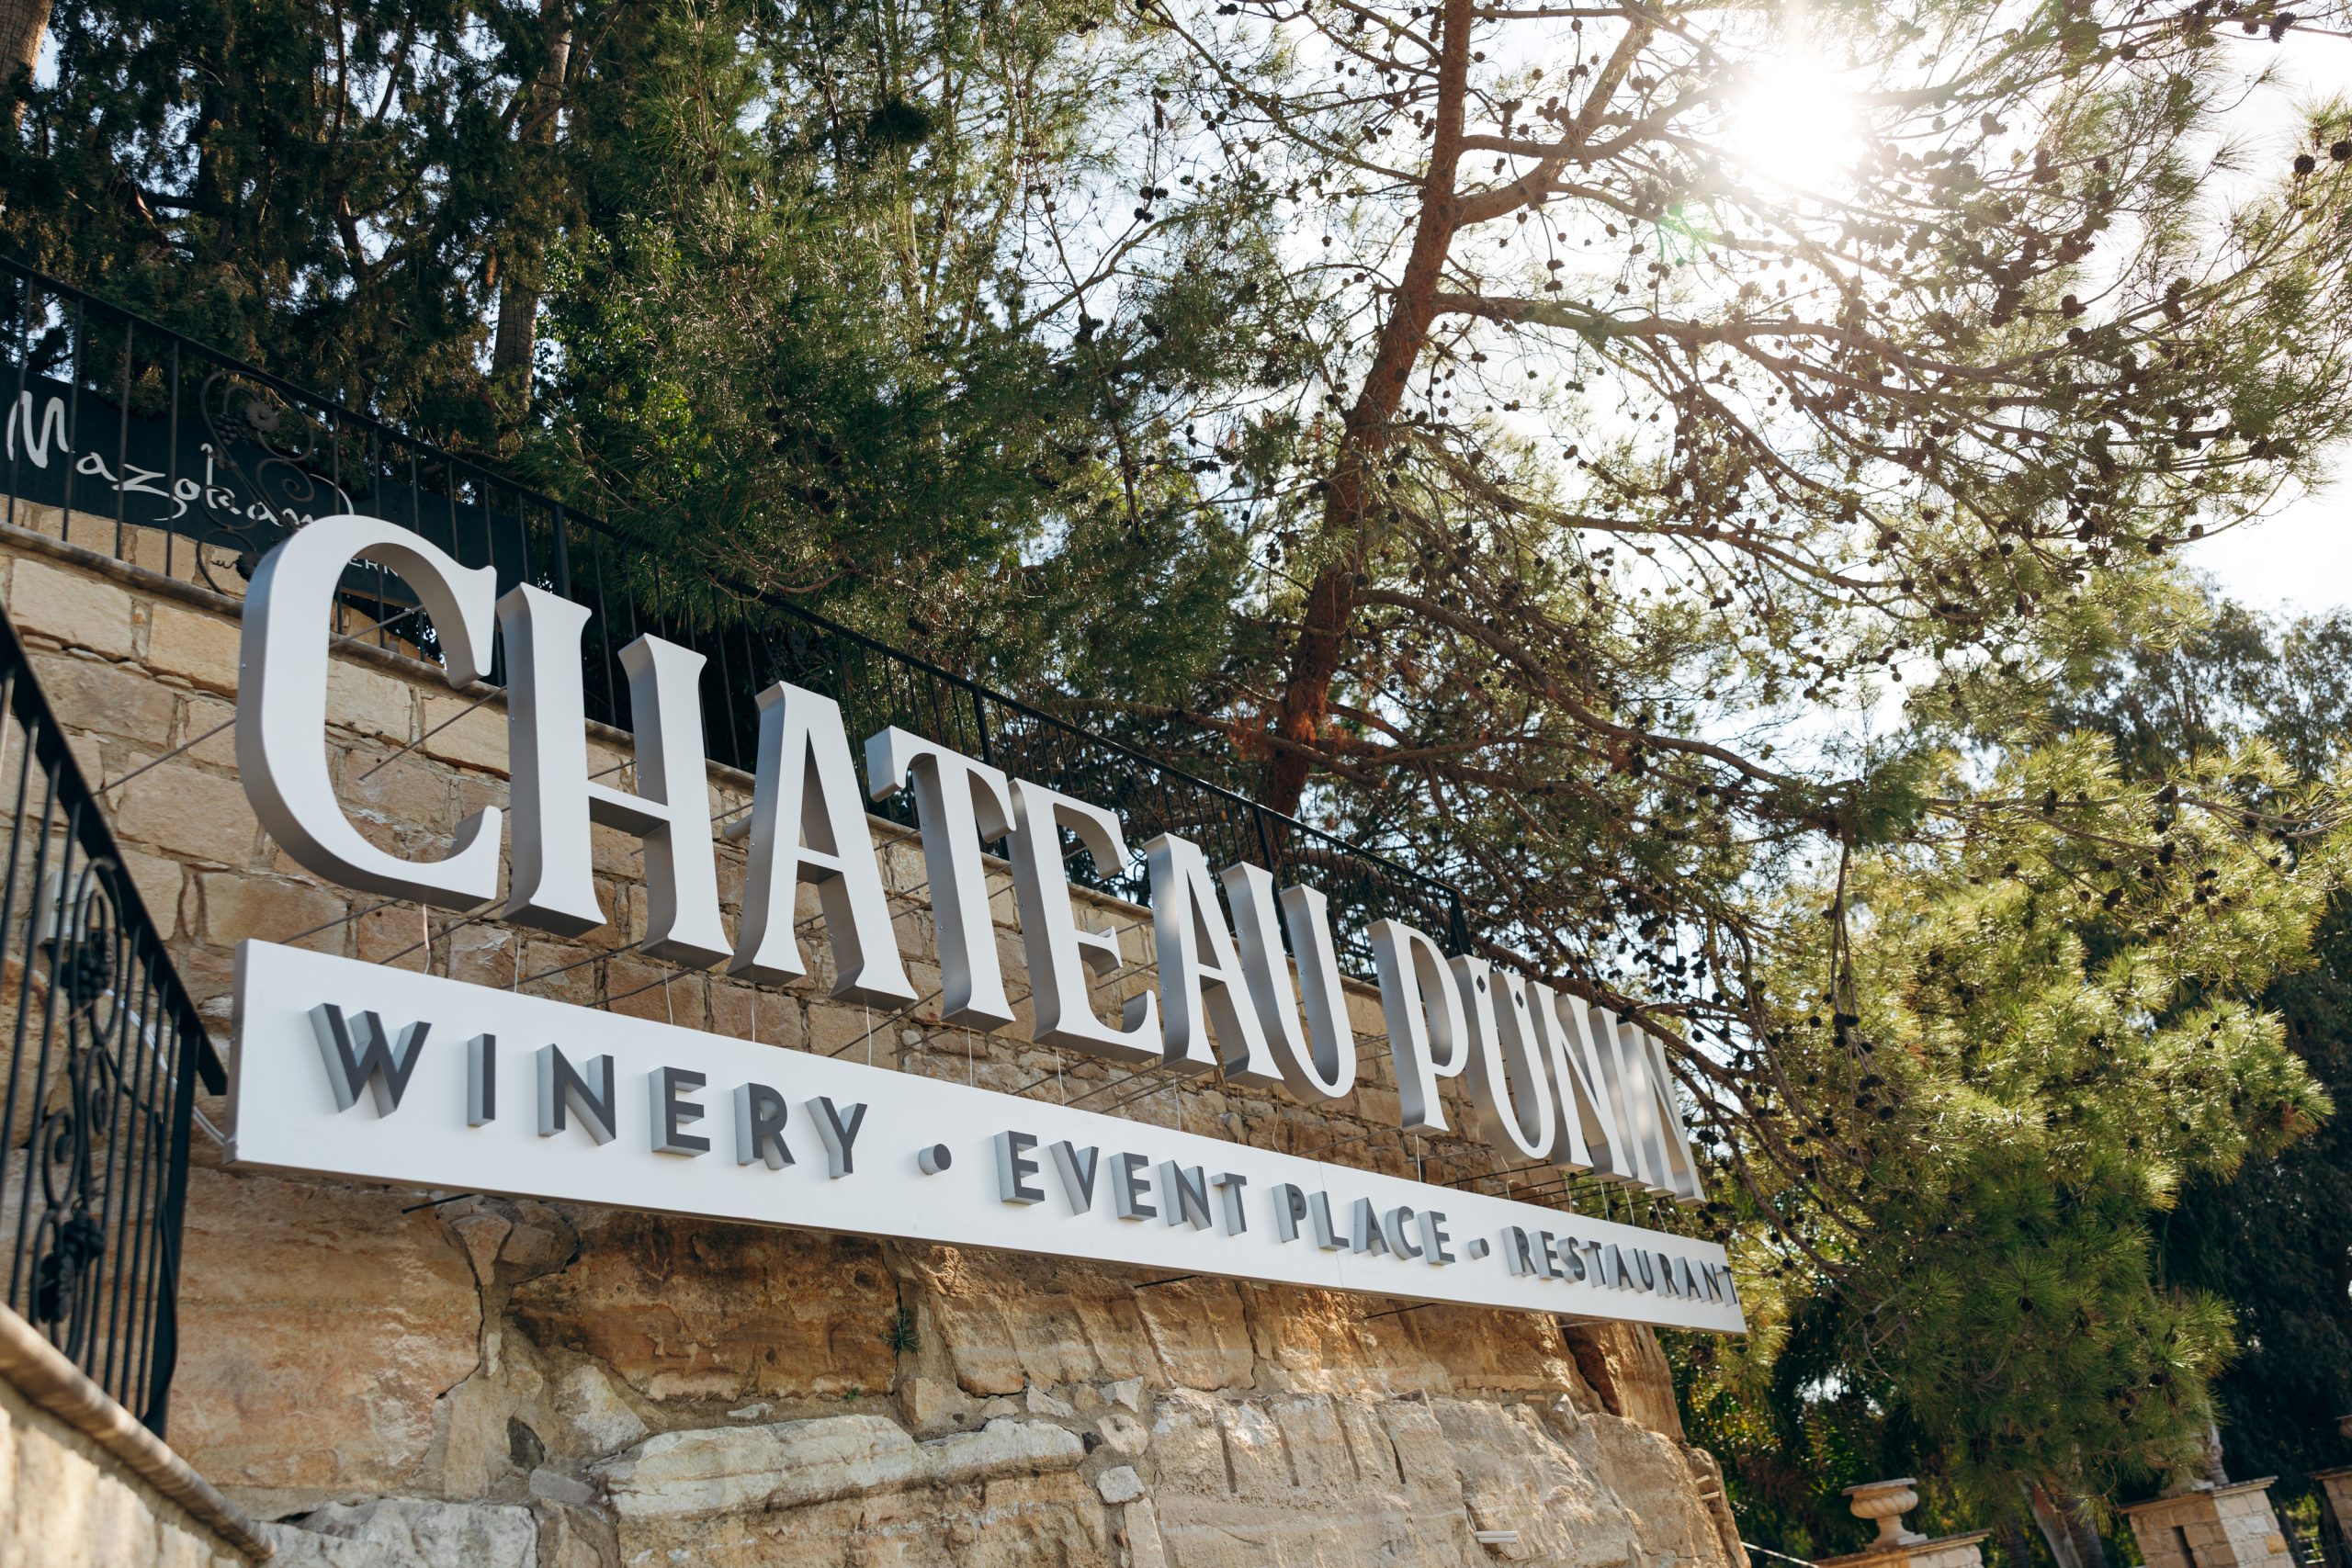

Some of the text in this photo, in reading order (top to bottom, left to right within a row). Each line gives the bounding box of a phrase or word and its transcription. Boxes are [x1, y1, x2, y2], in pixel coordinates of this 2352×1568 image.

[237, 513, 1358, 1101] CHATEAU
[308, 1002, 1738, 1307] WINERY EVENT PLACE RESTAURANT
